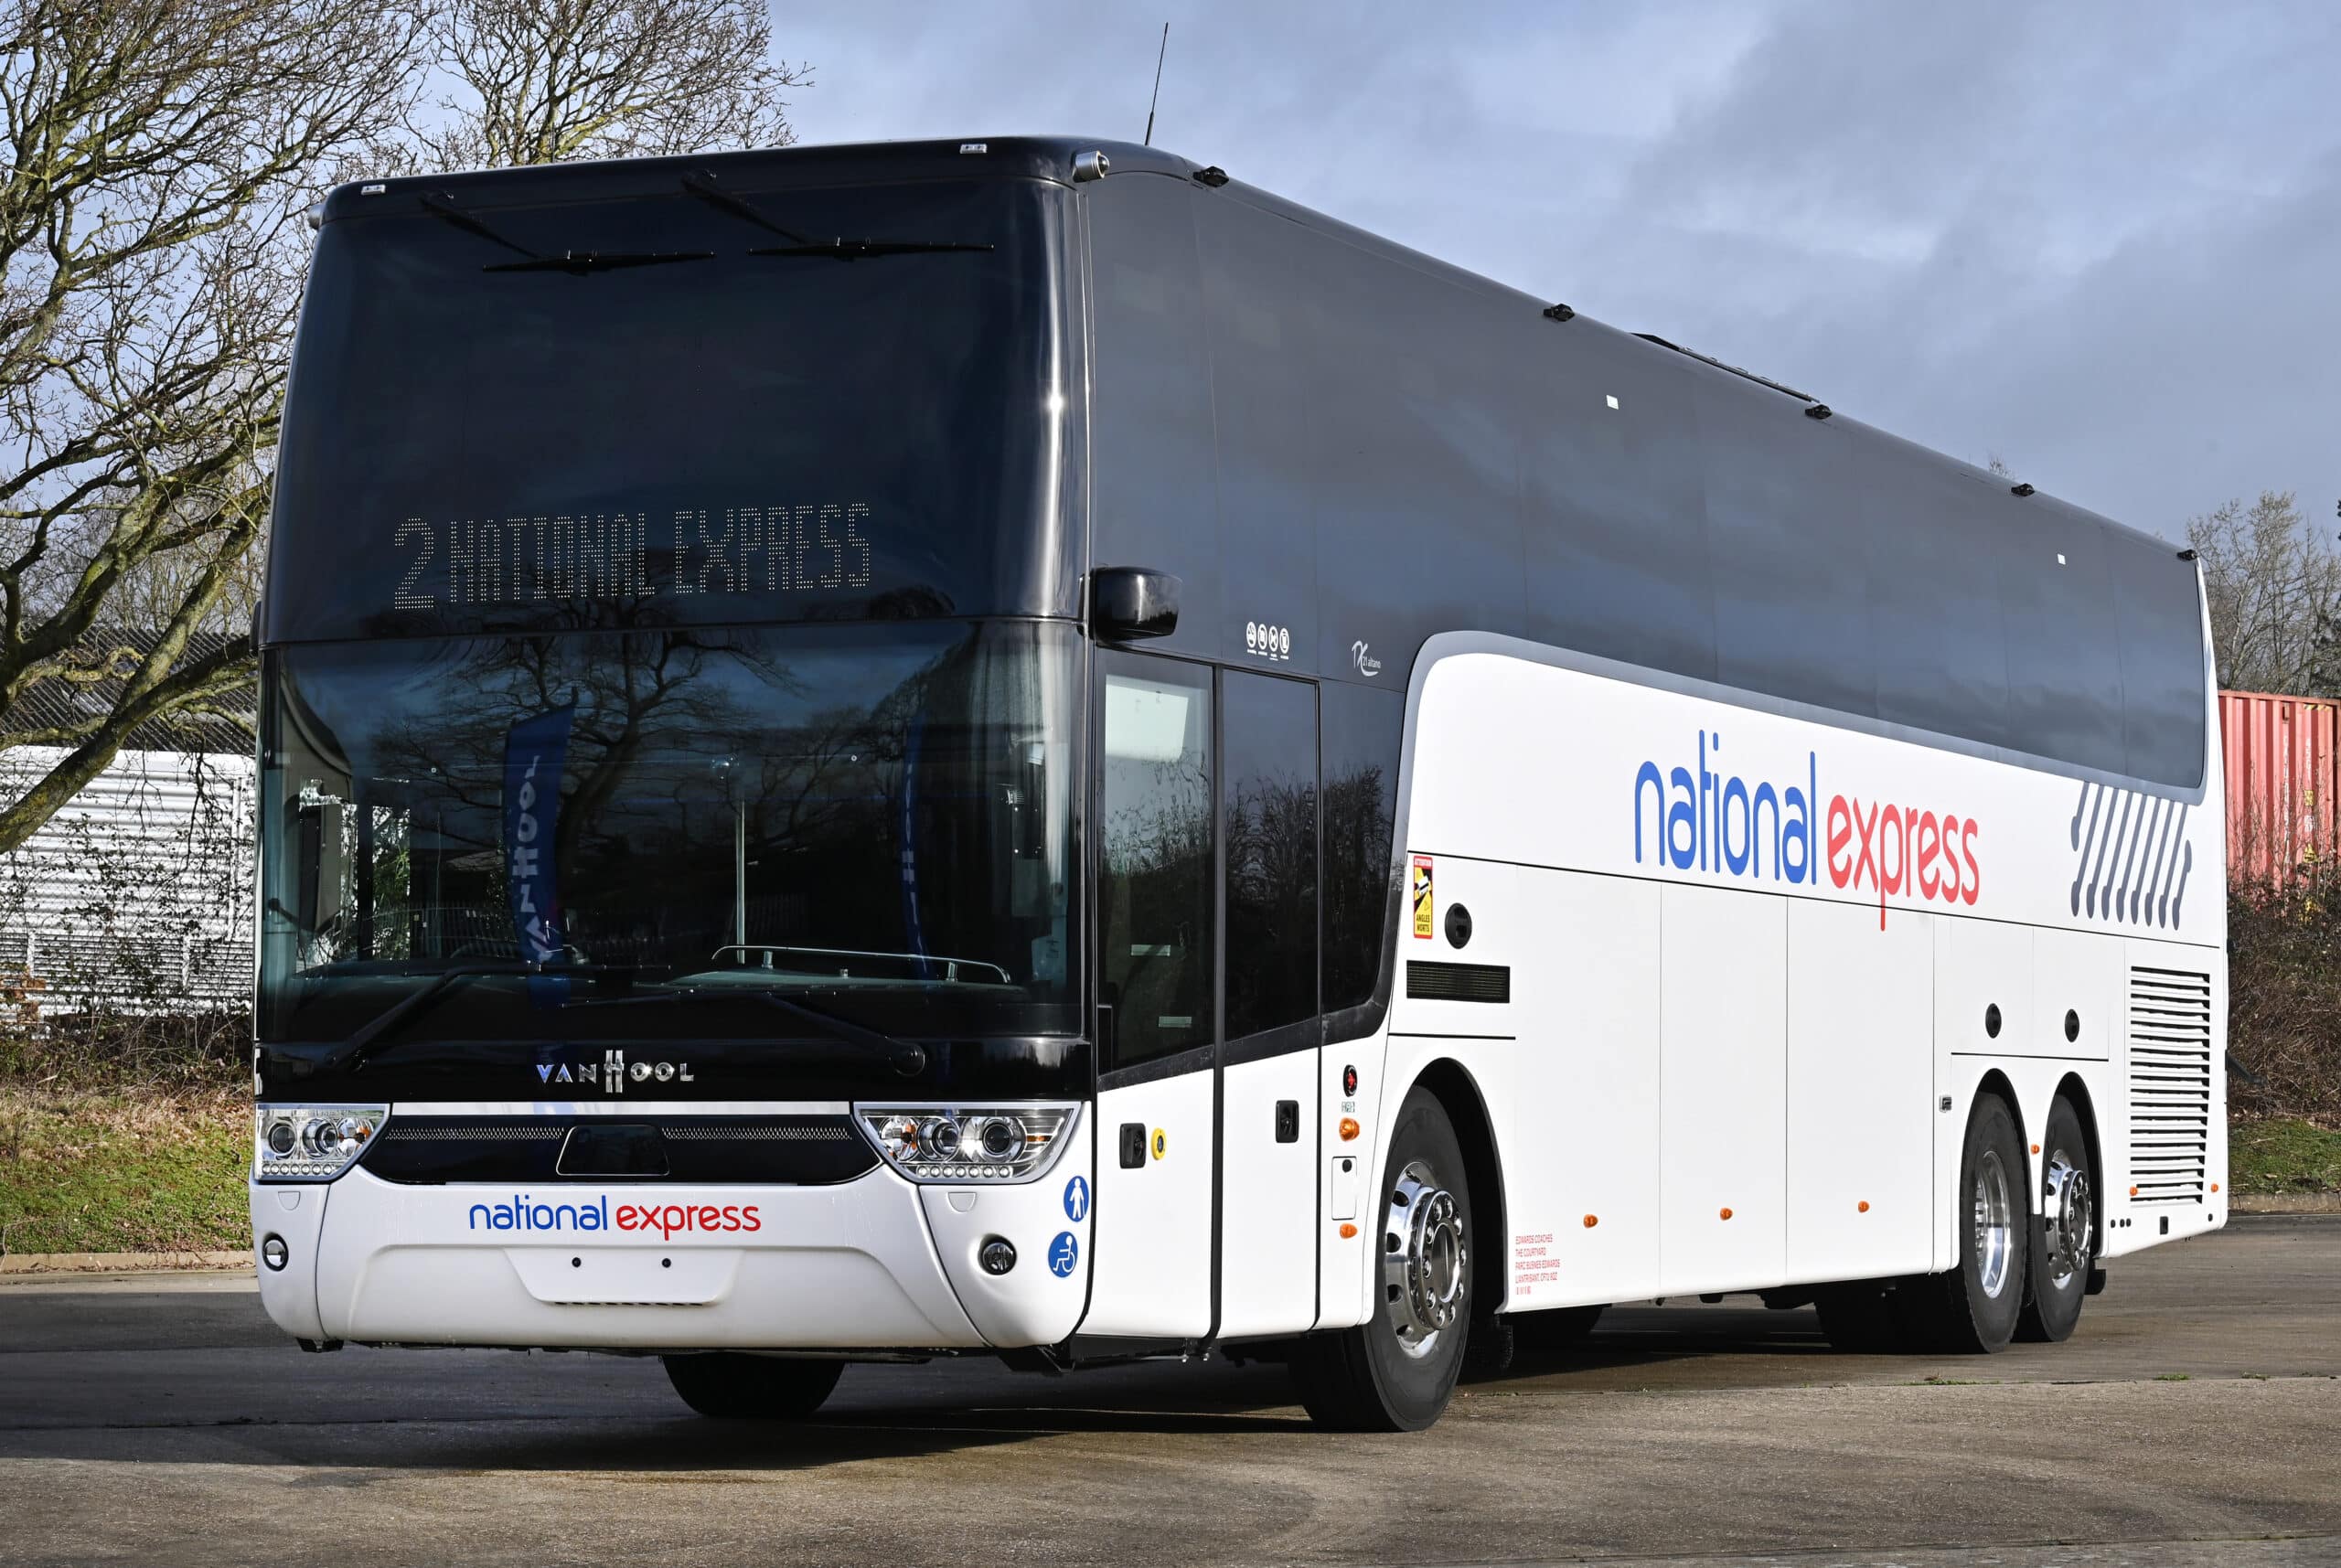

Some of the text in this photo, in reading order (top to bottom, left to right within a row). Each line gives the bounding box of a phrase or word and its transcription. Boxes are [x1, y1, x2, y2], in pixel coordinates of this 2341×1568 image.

[394, 503, 870, 610] 2 NATIONAL EXPRESS
[1634, 729, 1980, 932] national express
[1416, 914, 1430, 923] ANGLES
[535, 1050, 695, 1093] VANHOOL
[469, 1194, 762, 1241] national express
